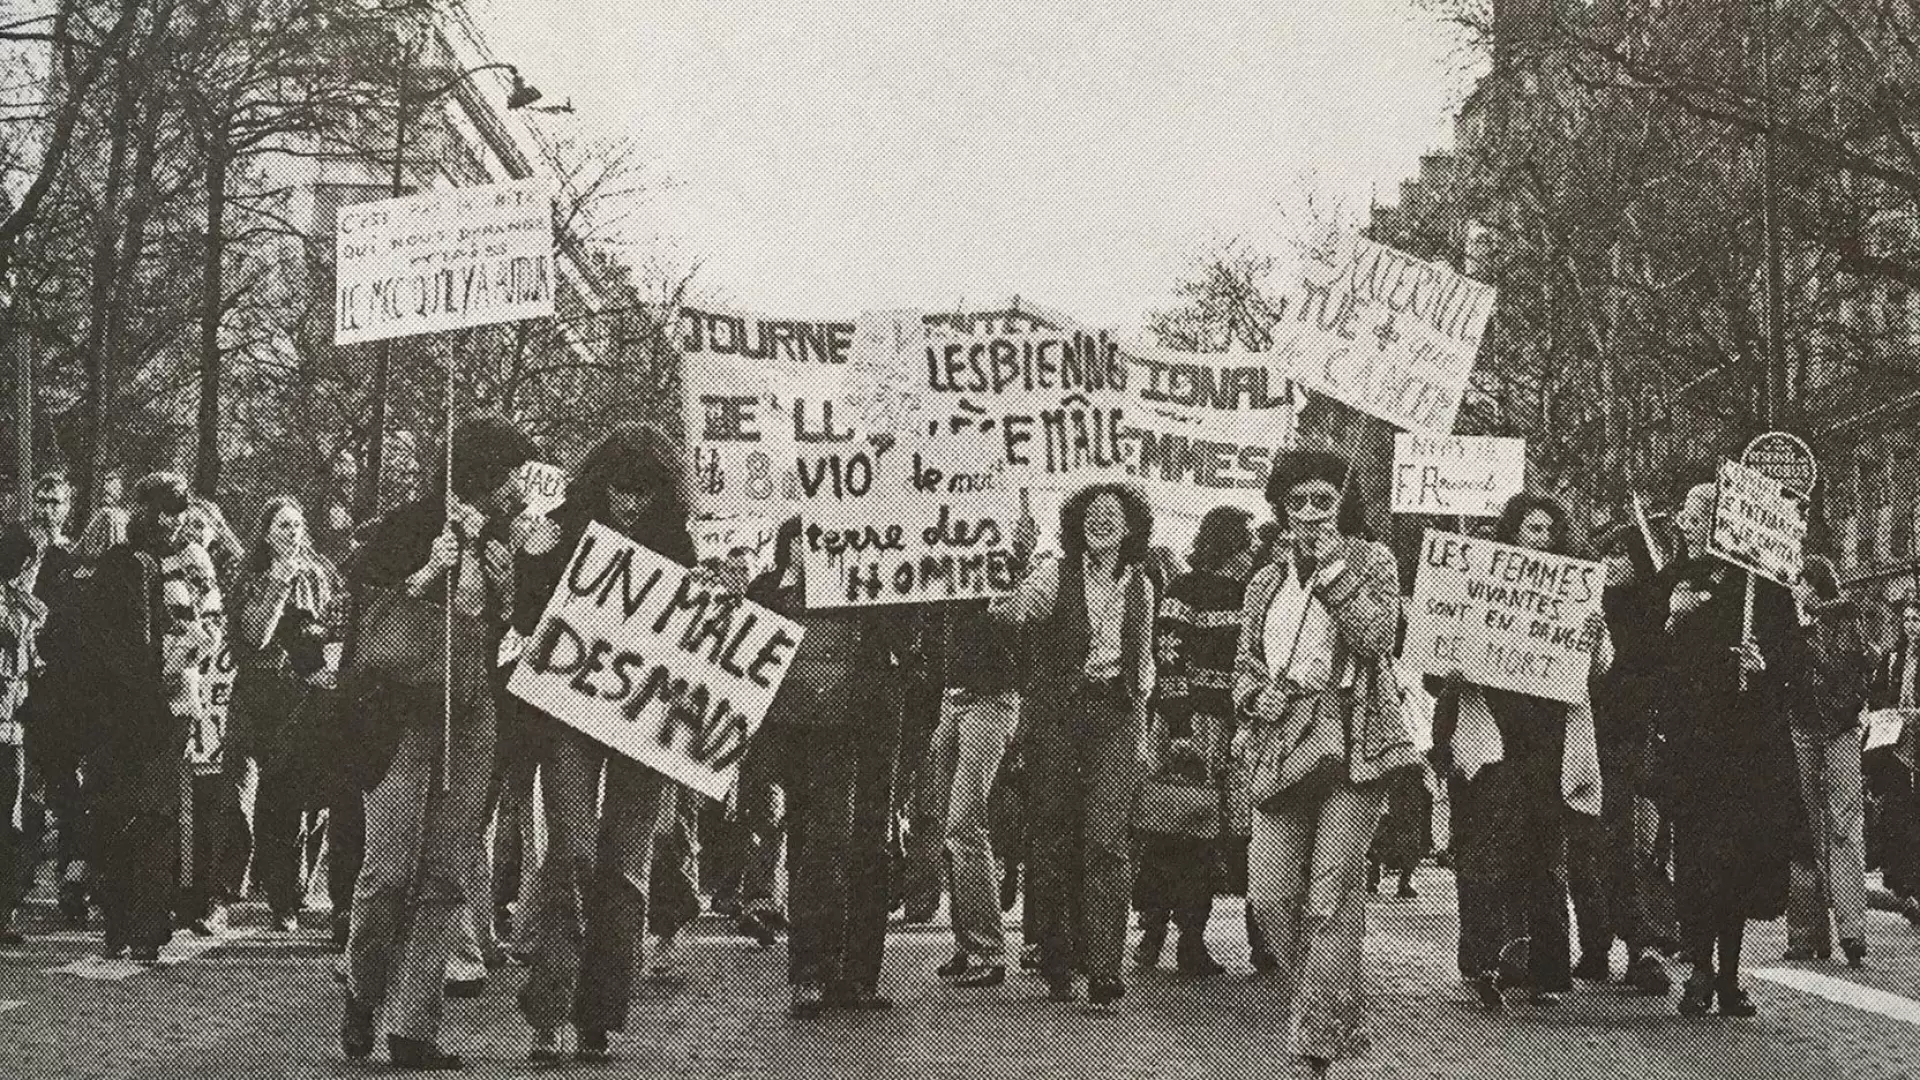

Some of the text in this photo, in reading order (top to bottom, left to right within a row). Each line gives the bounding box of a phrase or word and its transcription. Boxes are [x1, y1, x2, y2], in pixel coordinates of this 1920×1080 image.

[921, 503, 1001, 548] des
[567, 535, 664, 621] UN
[845, 548, 1025, 602] HOMME
[1426, 537, 1597, 605] LES FEMMES
[1425, 596, 1594, 655] SONT EN DANGE
[1466, 578, 1565, 622] VIVANTES
[1433, 634, 1557, 680] DE MORT
